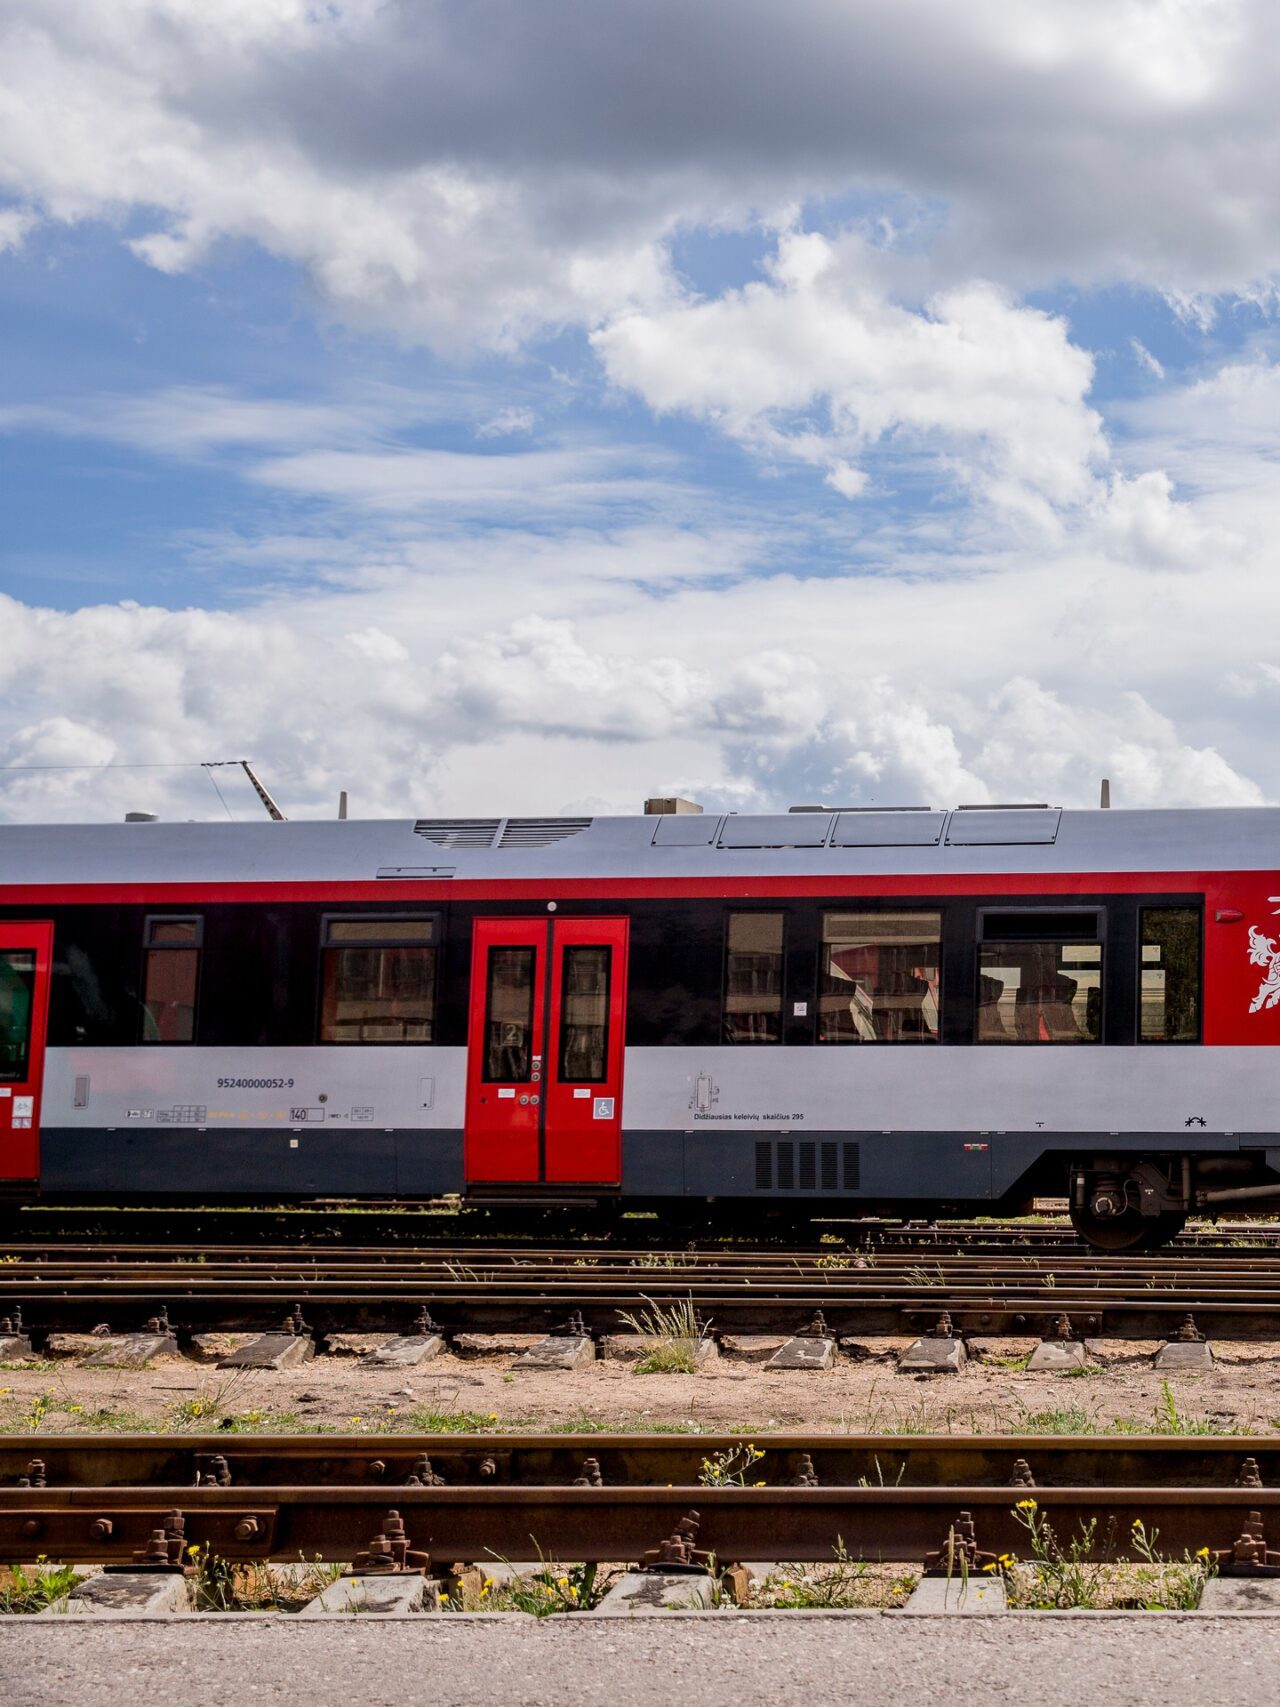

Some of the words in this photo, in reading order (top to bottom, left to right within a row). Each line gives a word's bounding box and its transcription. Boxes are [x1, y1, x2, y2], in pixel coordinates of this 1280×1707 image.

[506, 1024, 517, 1040] 2
[217, 1078, 295, 1089] 95240000052-9
[291, 1109, 306, 1120] 140
